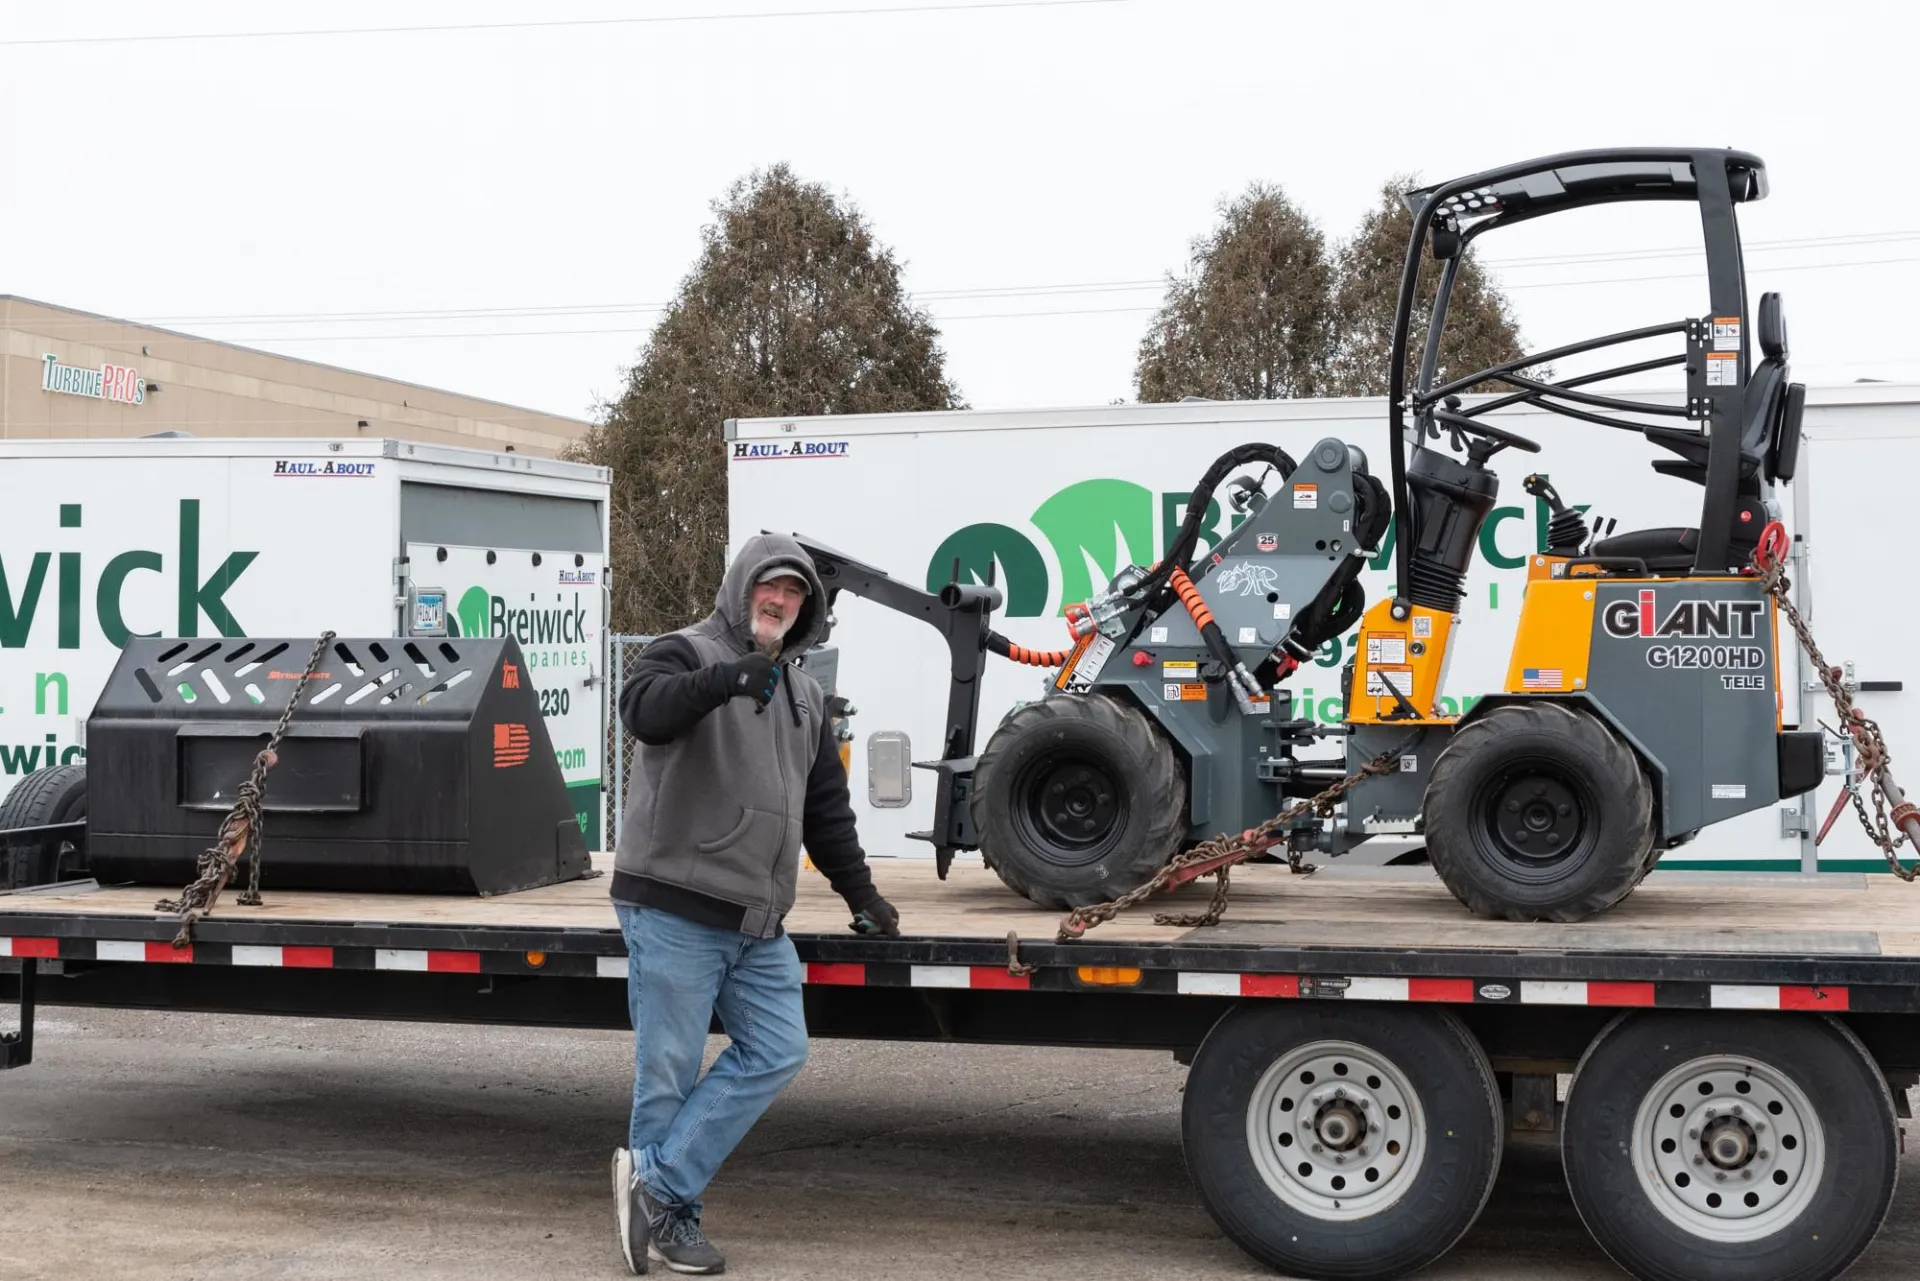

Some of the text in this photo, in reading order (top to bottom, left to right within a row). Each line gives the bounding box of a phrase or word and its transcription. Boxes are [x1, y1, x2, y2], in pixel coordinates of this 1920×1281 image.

[491, 592, 587, 645] Breiwick
[522, 650, 587, 672] panies
[1646, 645, 1765, 669] G1200HD
[1721, 675, 1765, 690] TELE
[534, 687, 570, 717] 230
